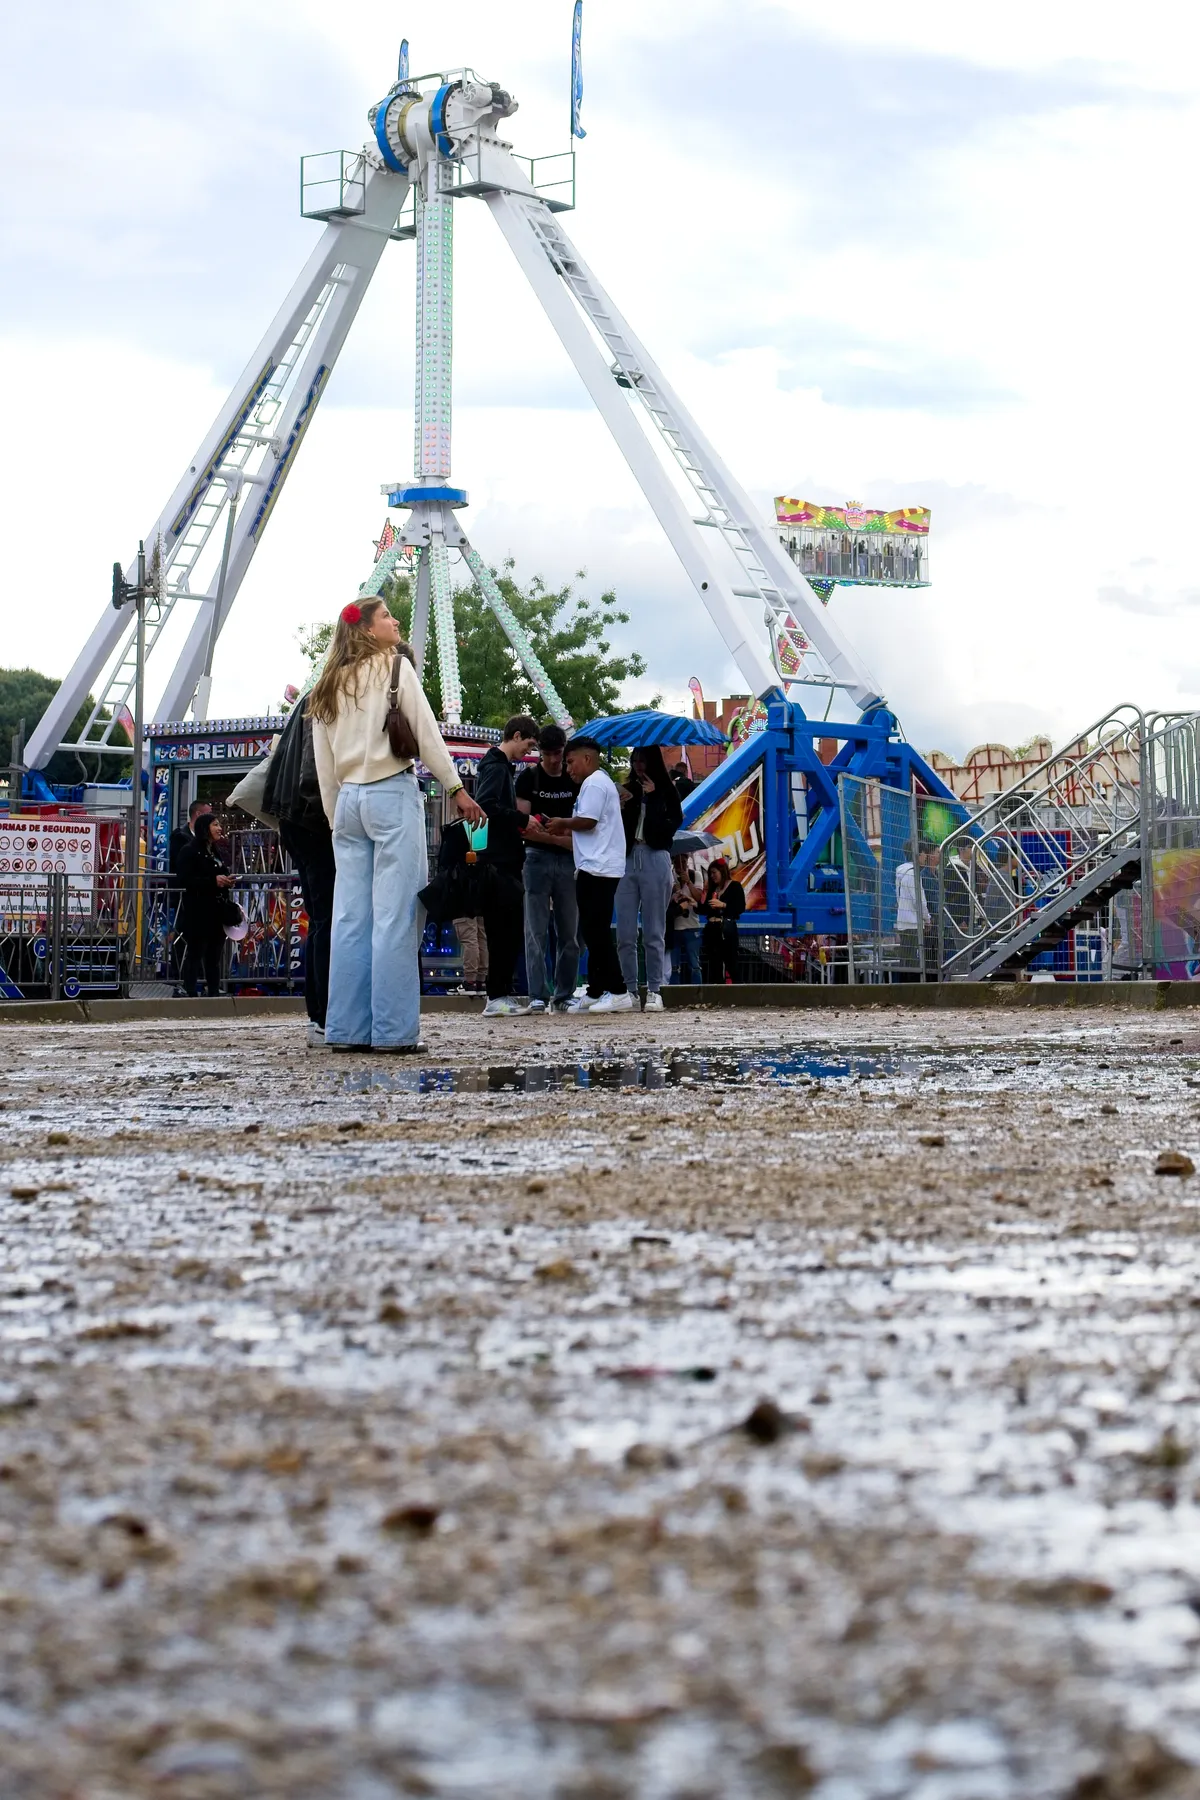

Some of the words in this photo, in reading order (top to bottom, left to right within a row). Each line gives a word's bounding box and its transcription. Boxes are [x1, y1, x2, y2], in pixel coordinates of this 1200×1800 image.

[193, 740, 272, 759] REMIX
[29, 824, 41, 832] DE
[42, 825, 91, 834] SEGURIDAD
[290, 885, 304, 970] NOVEDAD
